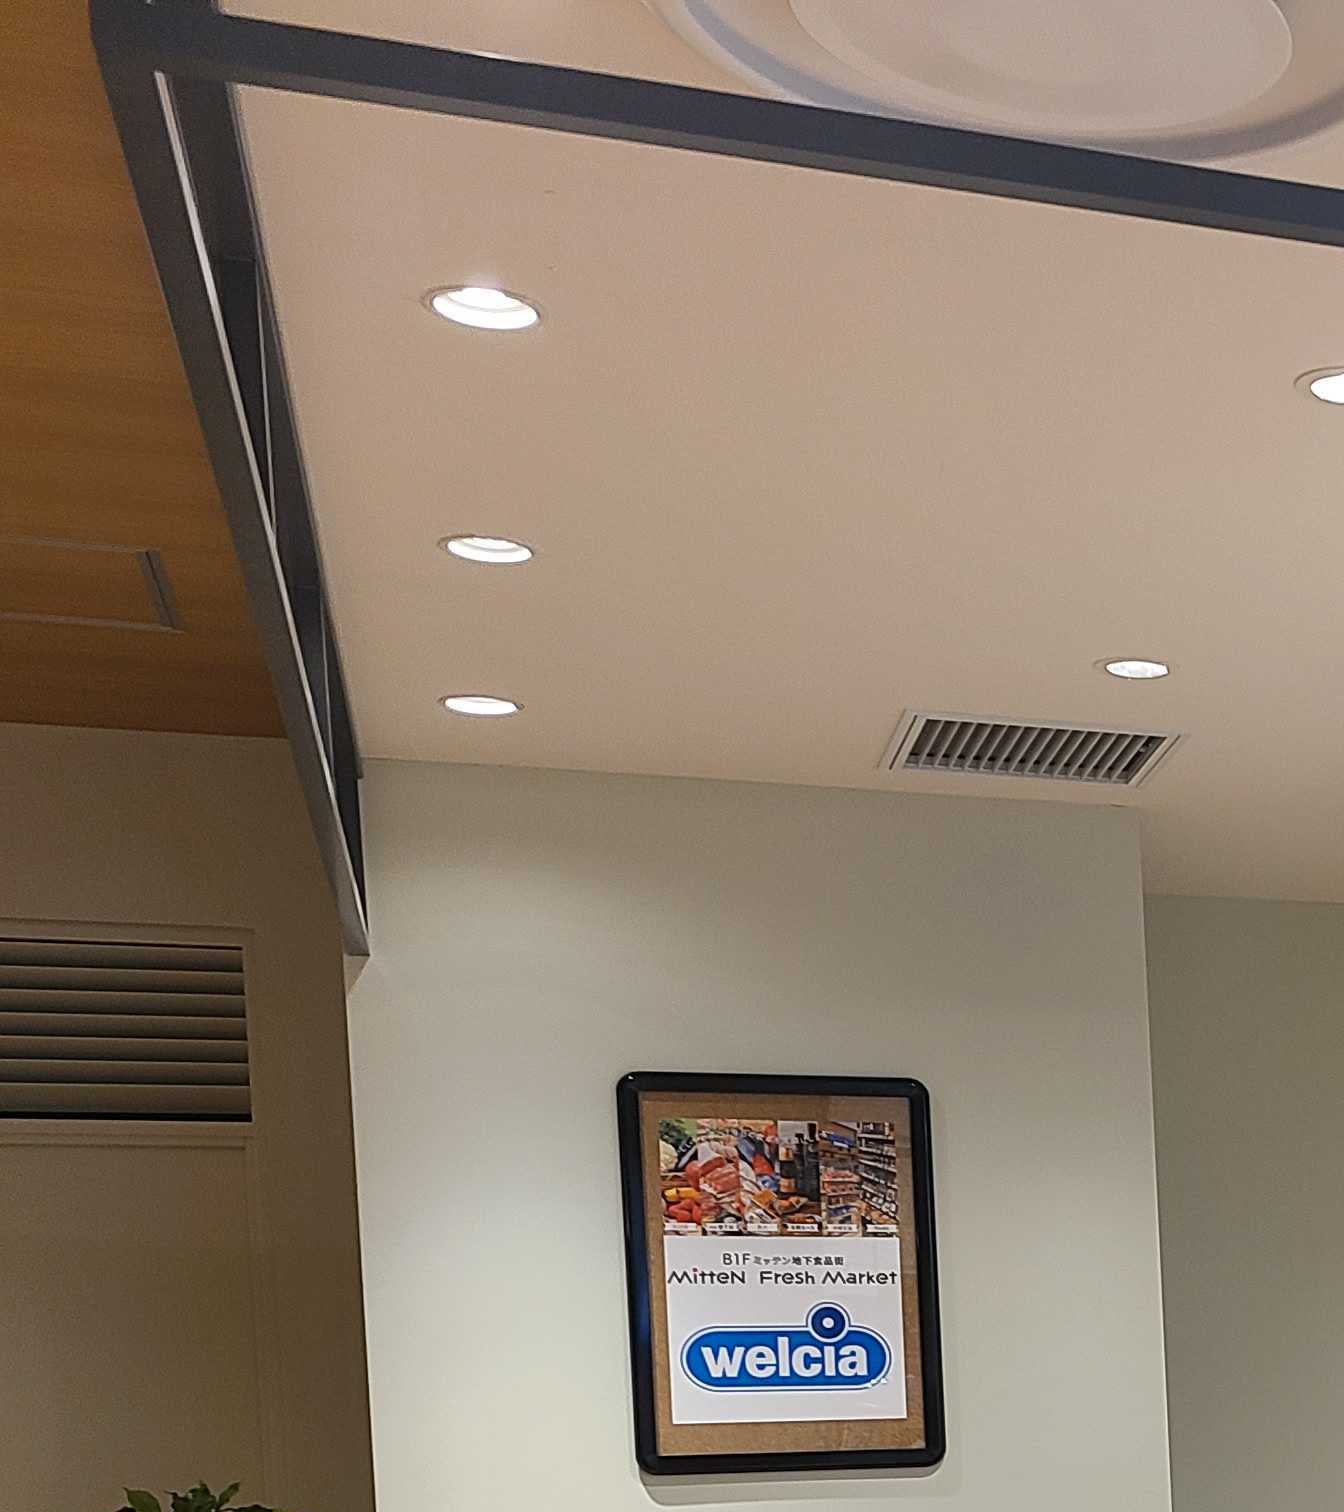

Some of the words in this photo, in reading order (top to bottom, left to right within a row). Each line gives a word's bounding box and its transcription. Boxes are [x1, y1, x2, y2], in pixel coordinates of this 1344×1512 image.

[722, 1252, 751, 1266] B1F
[753, 1255, 844, 1267] ミッテン地下食品街
[667, 1267, 746, 1285] MitteN
[759, 1270, 815, 1285] Fresh
[821, 1270, 899, 1285] Market
[700, 1306, 869, 1379] welcia
